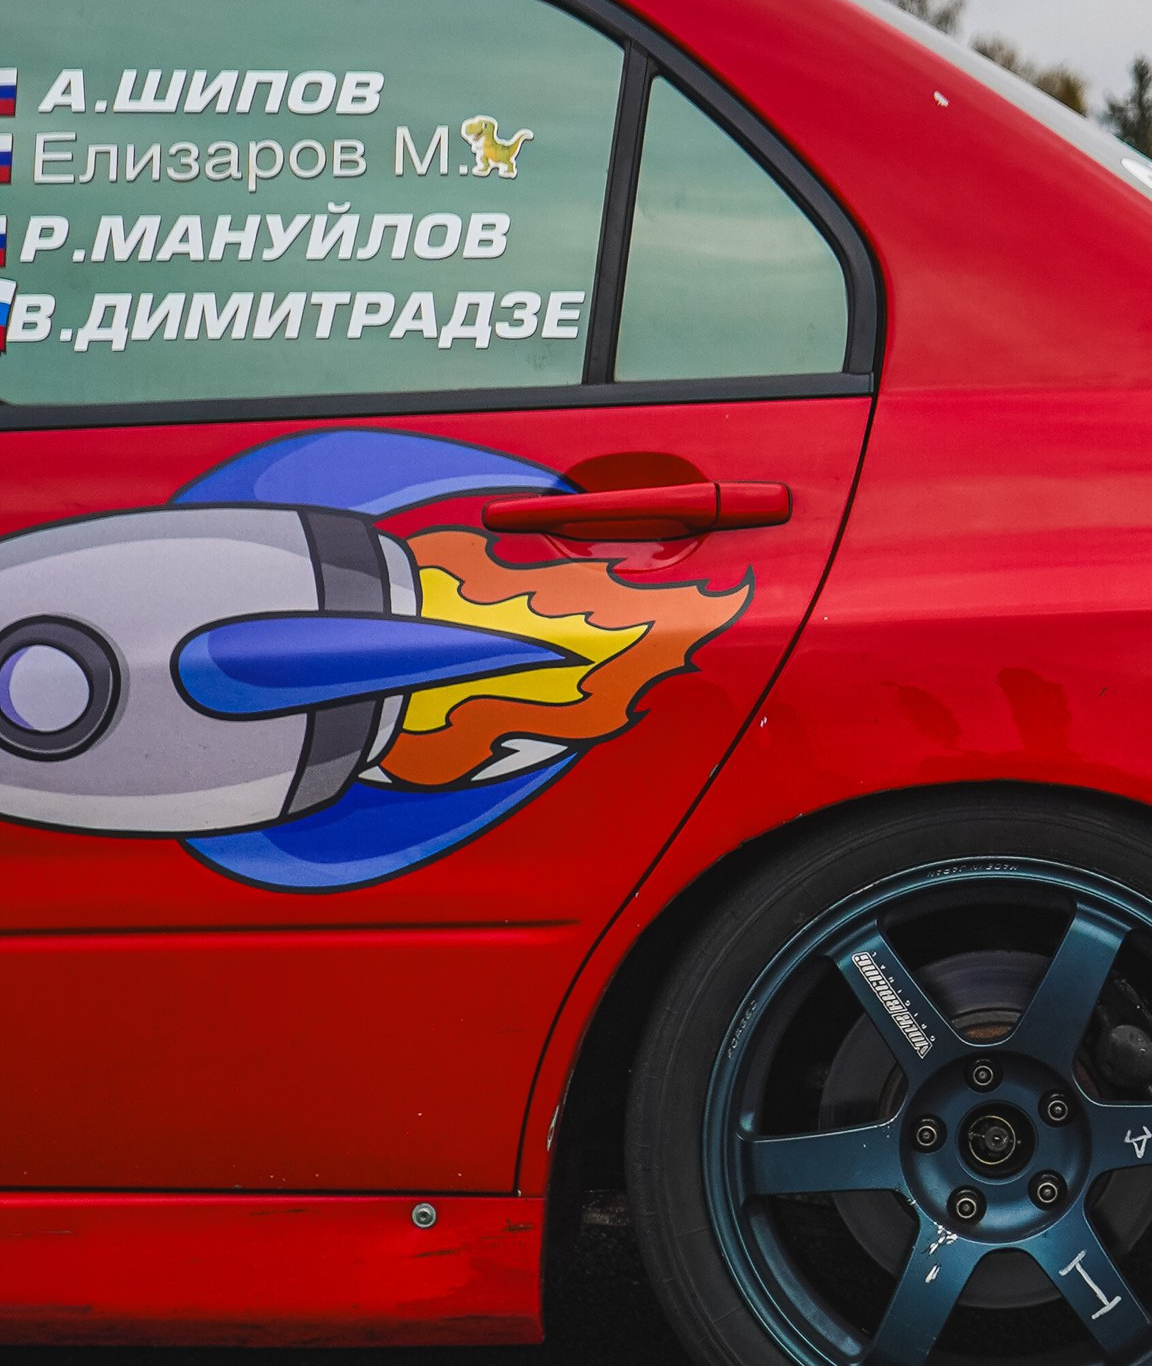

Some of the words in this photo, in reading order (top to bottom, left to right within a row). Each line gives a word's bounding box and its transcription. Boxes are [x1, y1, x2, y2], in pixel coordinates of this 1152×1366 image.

[37, 67, 386, 115] А.ШИПОВ
[33, 130, 368, 192] Елизаров
[394, 124, 470, 177] М.
[19, 201, 512, 263] Р.МАНУЙЛОВ
[9, 290, 587, 352] В.ДИМИТРАДЗЕ
[851, 951, 903, 1017] RACING
[871, 951, 936, 1042] ORIGINAL
[893, 1010, 934, 1059] VOLK
